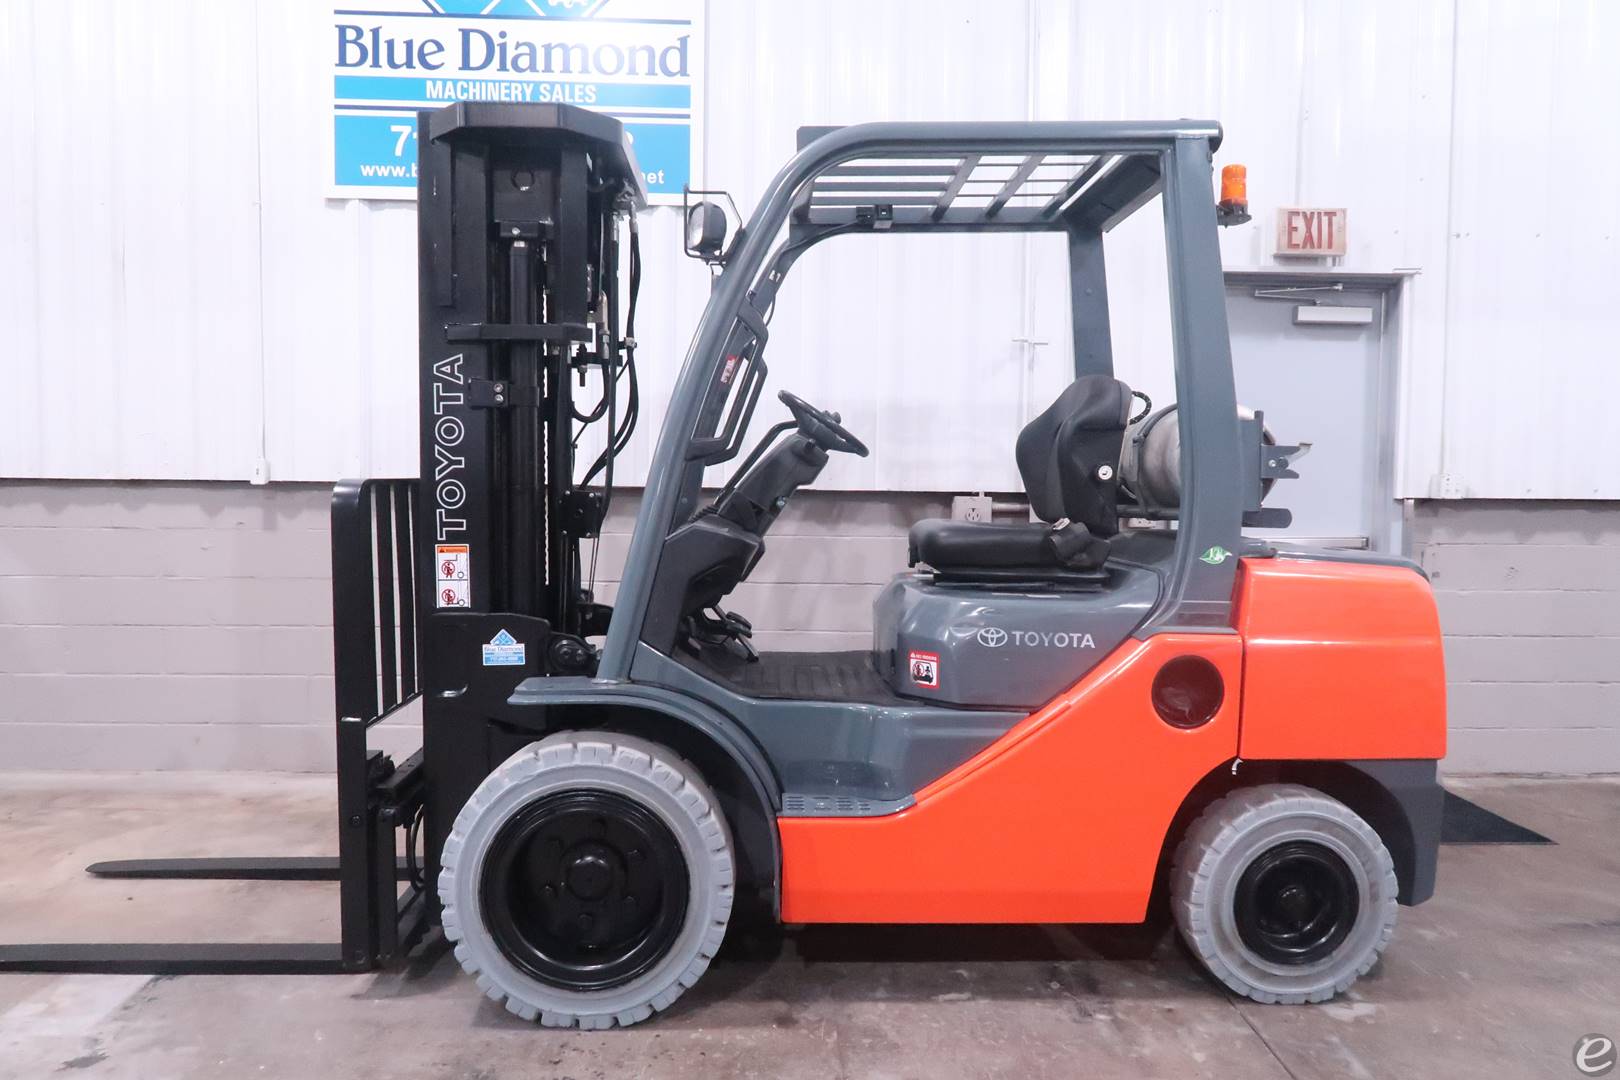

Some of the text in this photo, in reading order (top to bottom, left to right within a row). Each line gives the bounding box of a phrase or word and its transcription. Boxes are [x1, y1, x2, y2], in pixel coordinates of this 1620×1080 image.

[335, 25, 691, 77] Blue Diamond
[426, 80, 597, 103] MACHINERY SALES
[1287, 211, 1337, 250] EXIT
[433, 353, 467, 541] TOYOTA
[1011, 631, 1096, 649] TOYOTA
